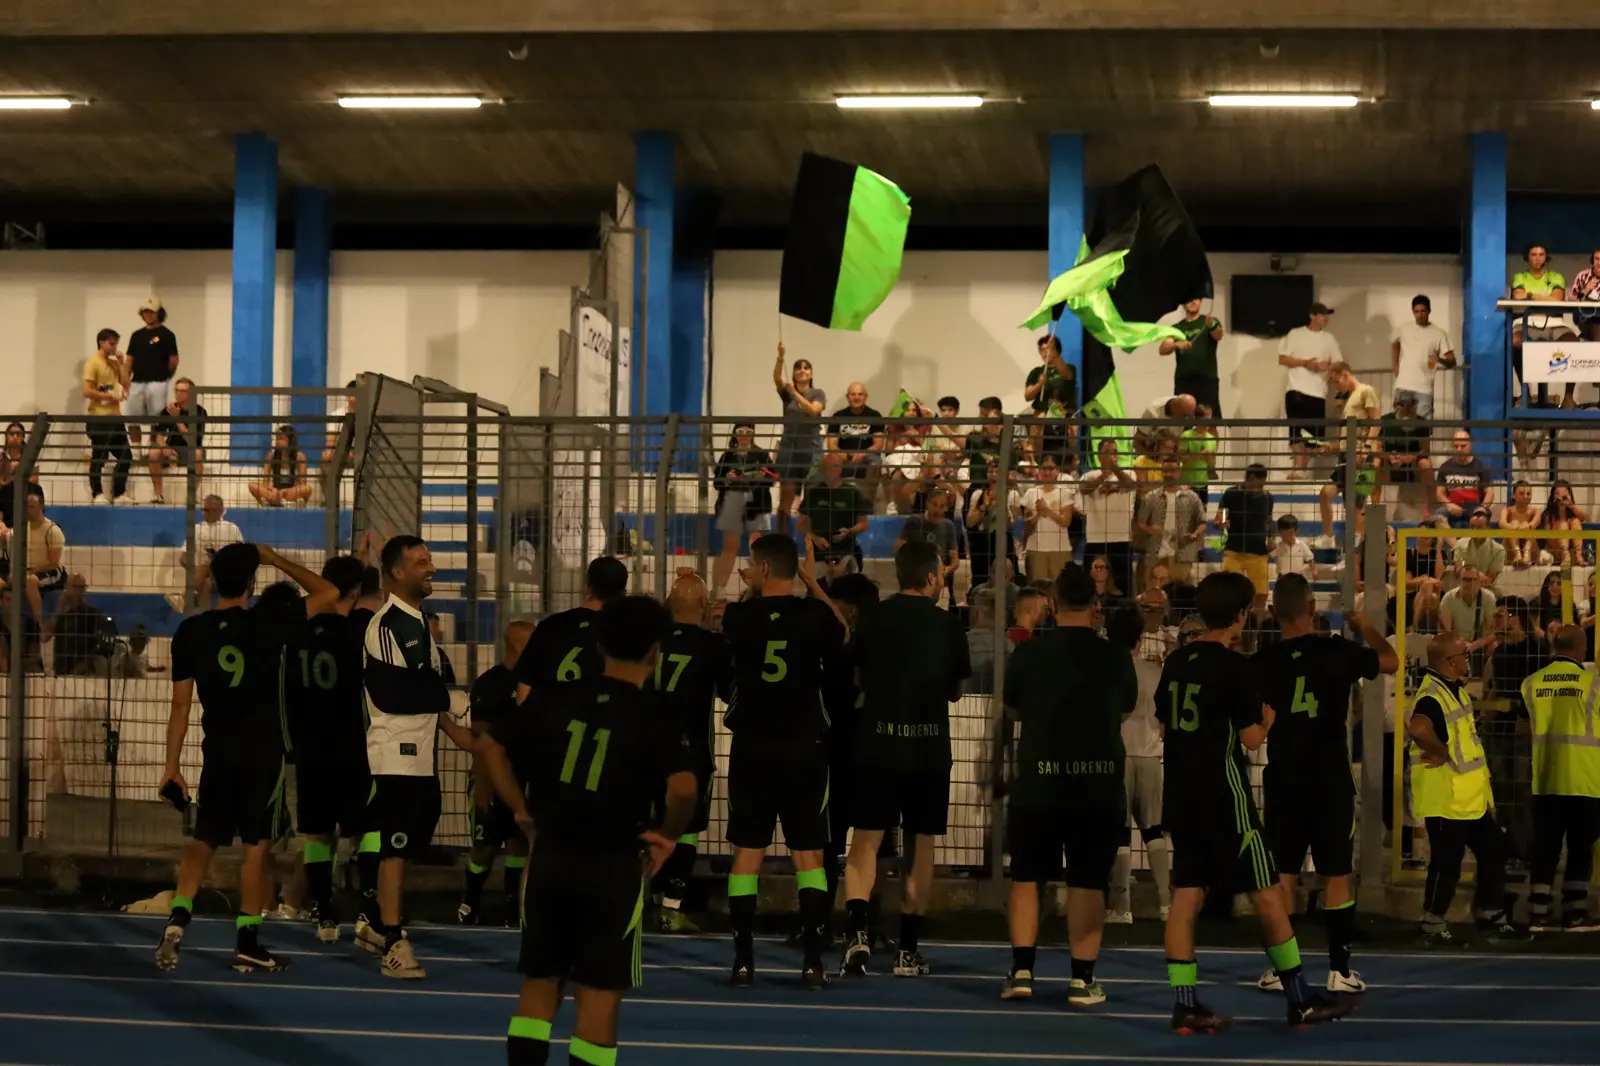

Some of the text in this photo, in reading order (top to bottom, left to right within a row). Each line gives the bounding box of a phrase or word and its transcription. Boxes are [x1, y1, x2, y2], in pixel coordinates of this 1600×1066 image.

[217, 644, 245, 688] 9
[298, 649, 338, 690] 10
[556, 646, 583, 682] 6
[760, 640, 788, 682] 5
[1168, 680, 1202, 732] 15
[1290, 675, 1319, 719] 4
[559, 719, 611, 792] 11
[1037, 760, 1115, 775] SAN LORENZO
